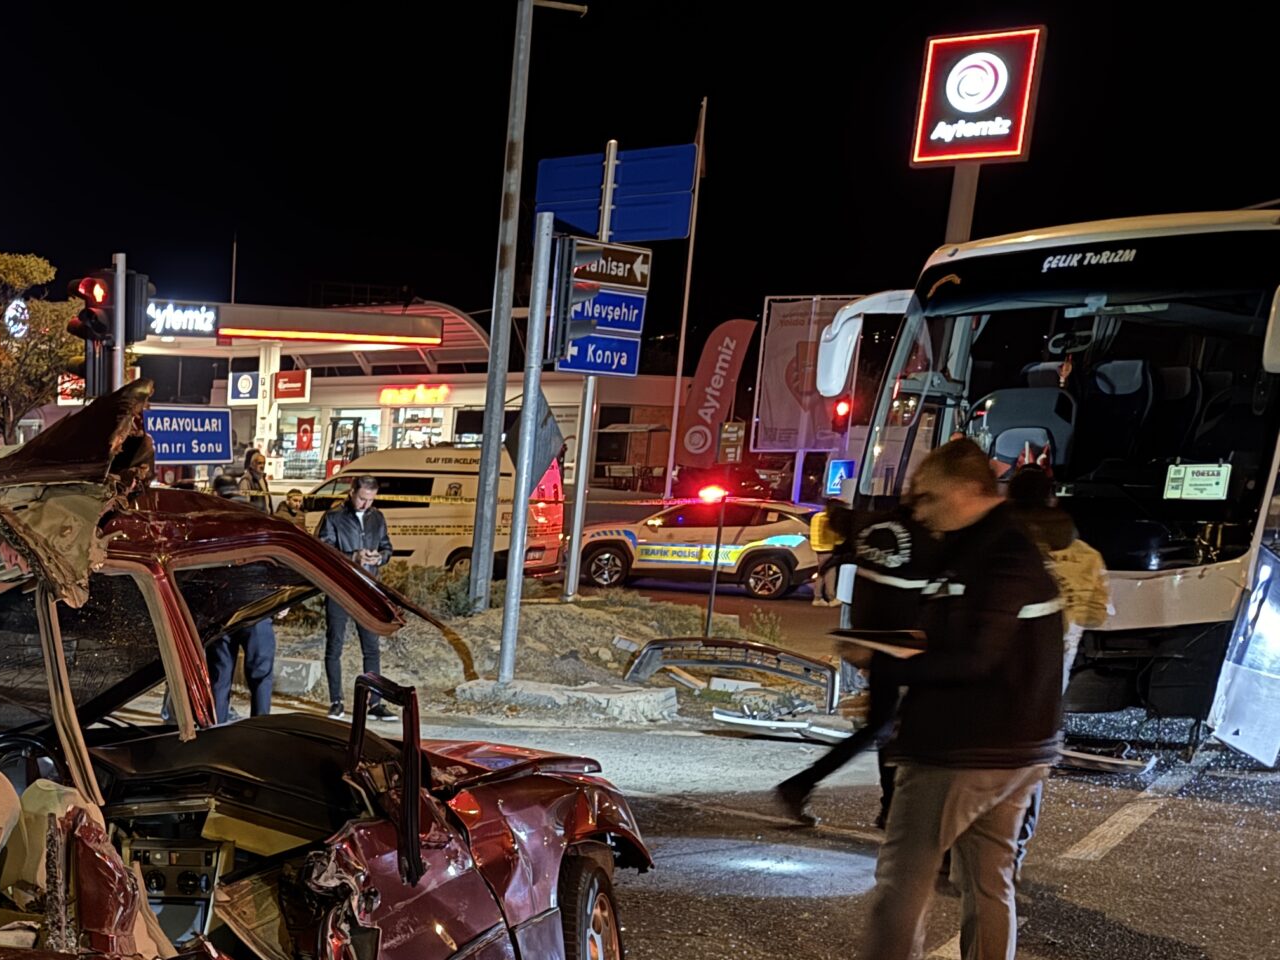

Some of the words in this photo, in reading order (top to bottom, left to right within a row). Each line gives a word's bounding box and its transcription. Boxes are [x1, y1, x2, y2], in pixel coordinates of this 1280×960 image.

[930, 116, 1012, 142] Aytemiz
[584, 299, 639, 322] Nevşehir
[586, 343, 628, 369] Konya
[697, 336, 737, 424] Aytemiz
[147, 417, 222, 432] KARAYOLLARI
[191, 440, 223, 453] Sonu
